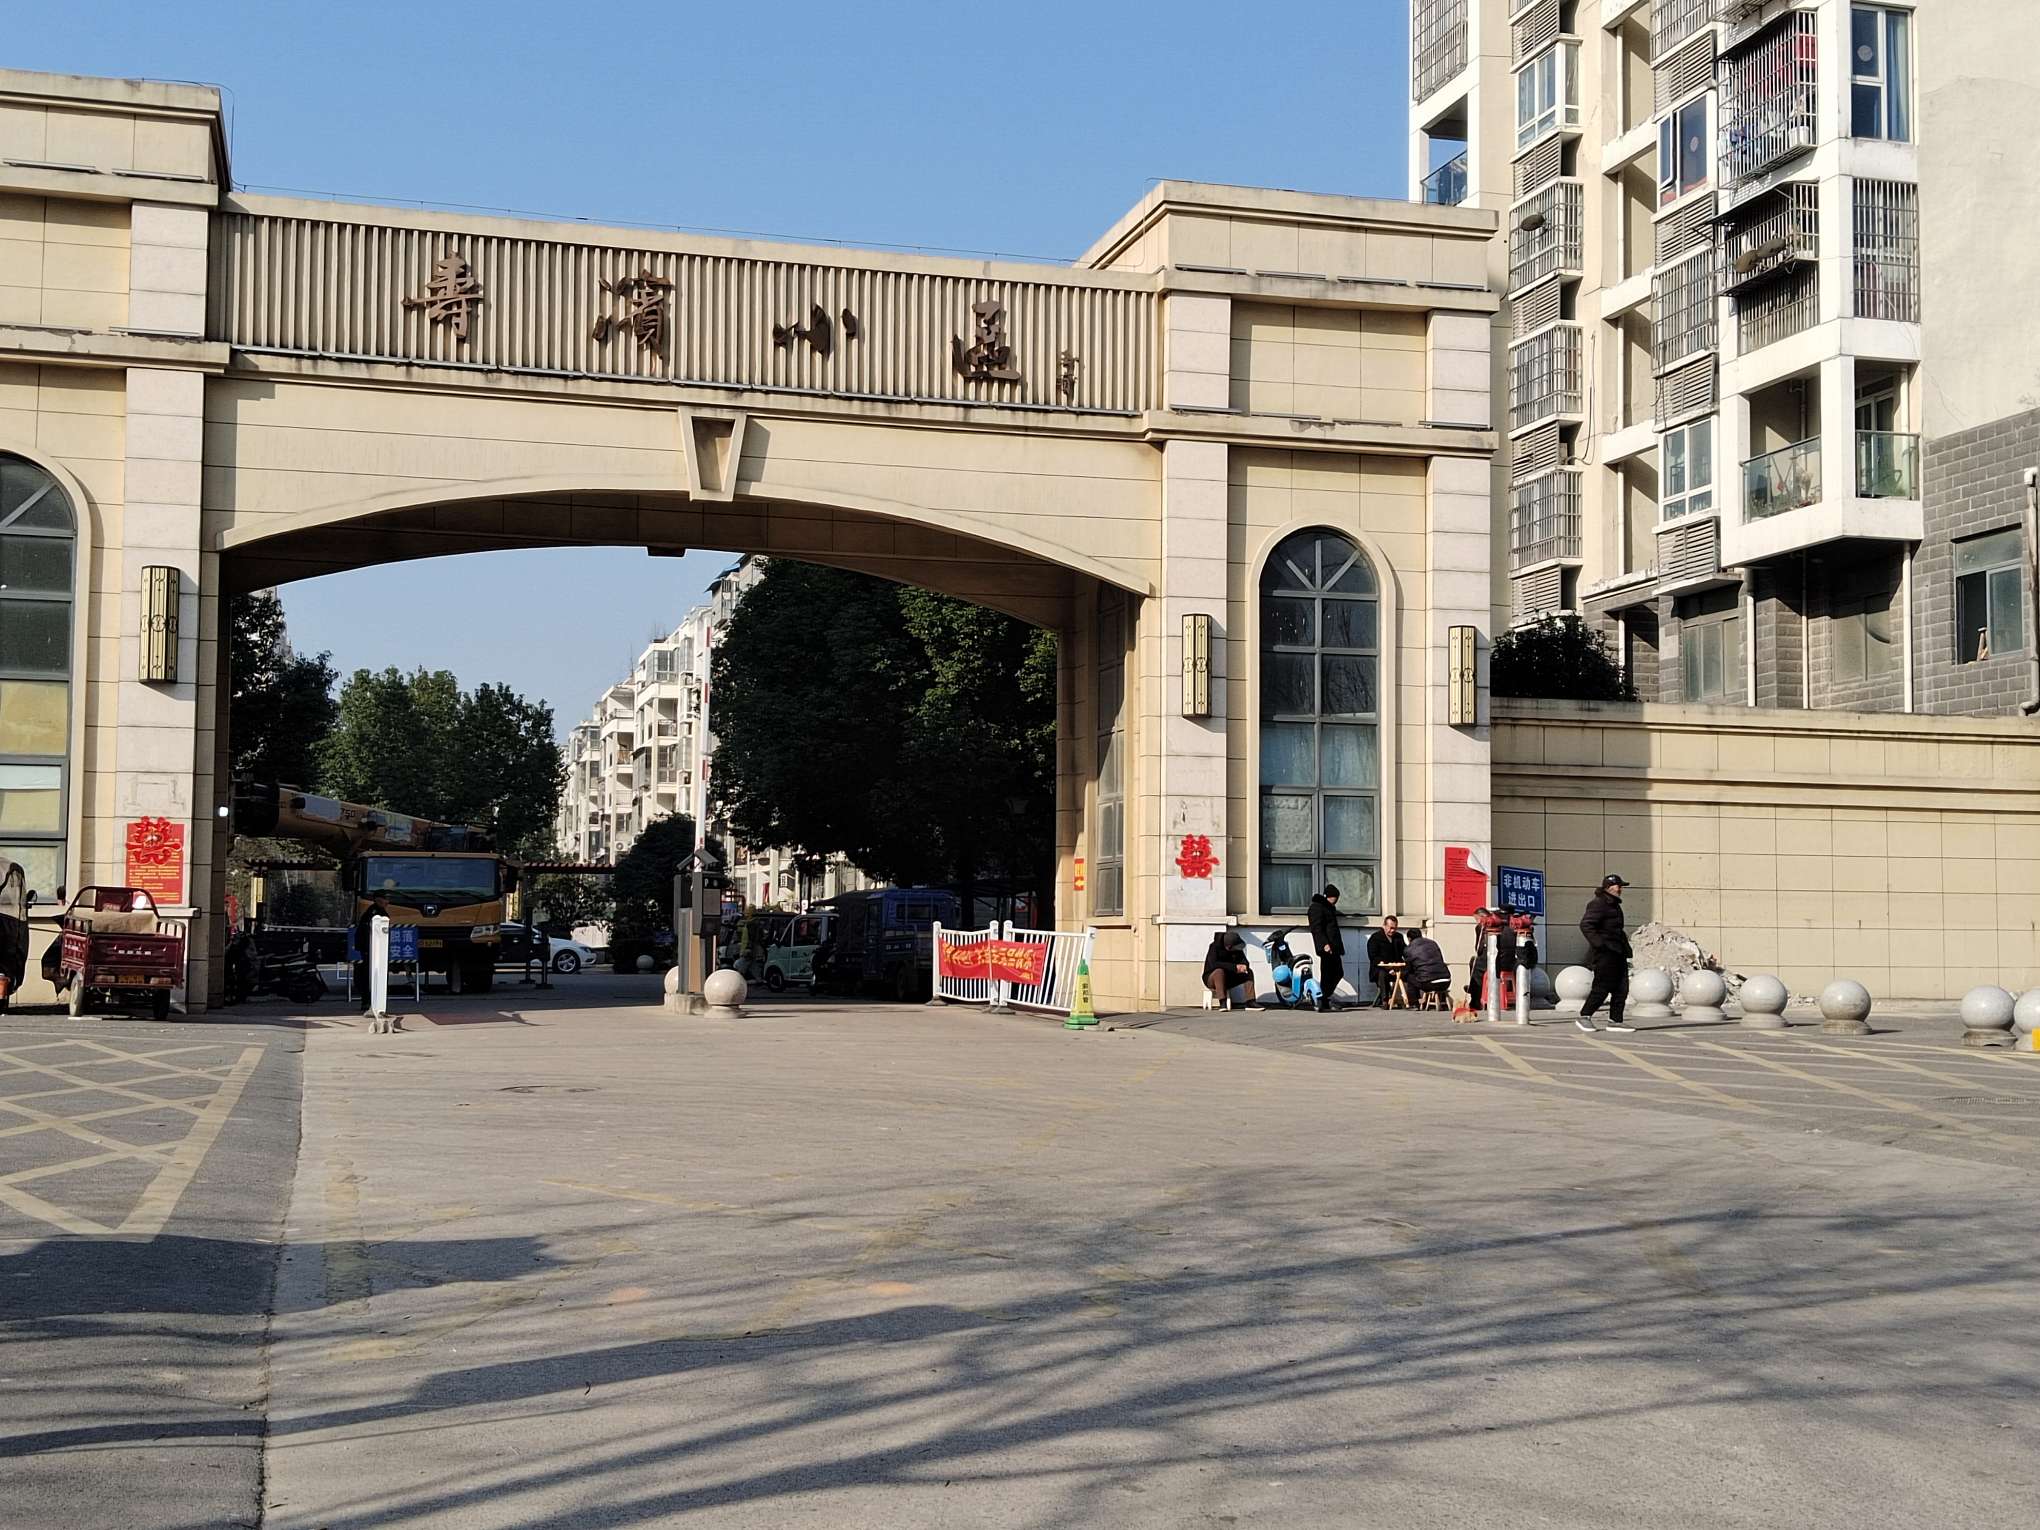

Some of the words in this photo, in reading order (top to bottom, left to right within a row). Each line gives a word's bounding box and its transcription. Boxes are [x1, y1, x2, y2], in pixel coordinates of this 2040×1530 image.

[1504, 874, 1540, 892] 非机动车
[1508, 892, 1535, 907] 进出口
[390, 945, 413, 958] 安全
